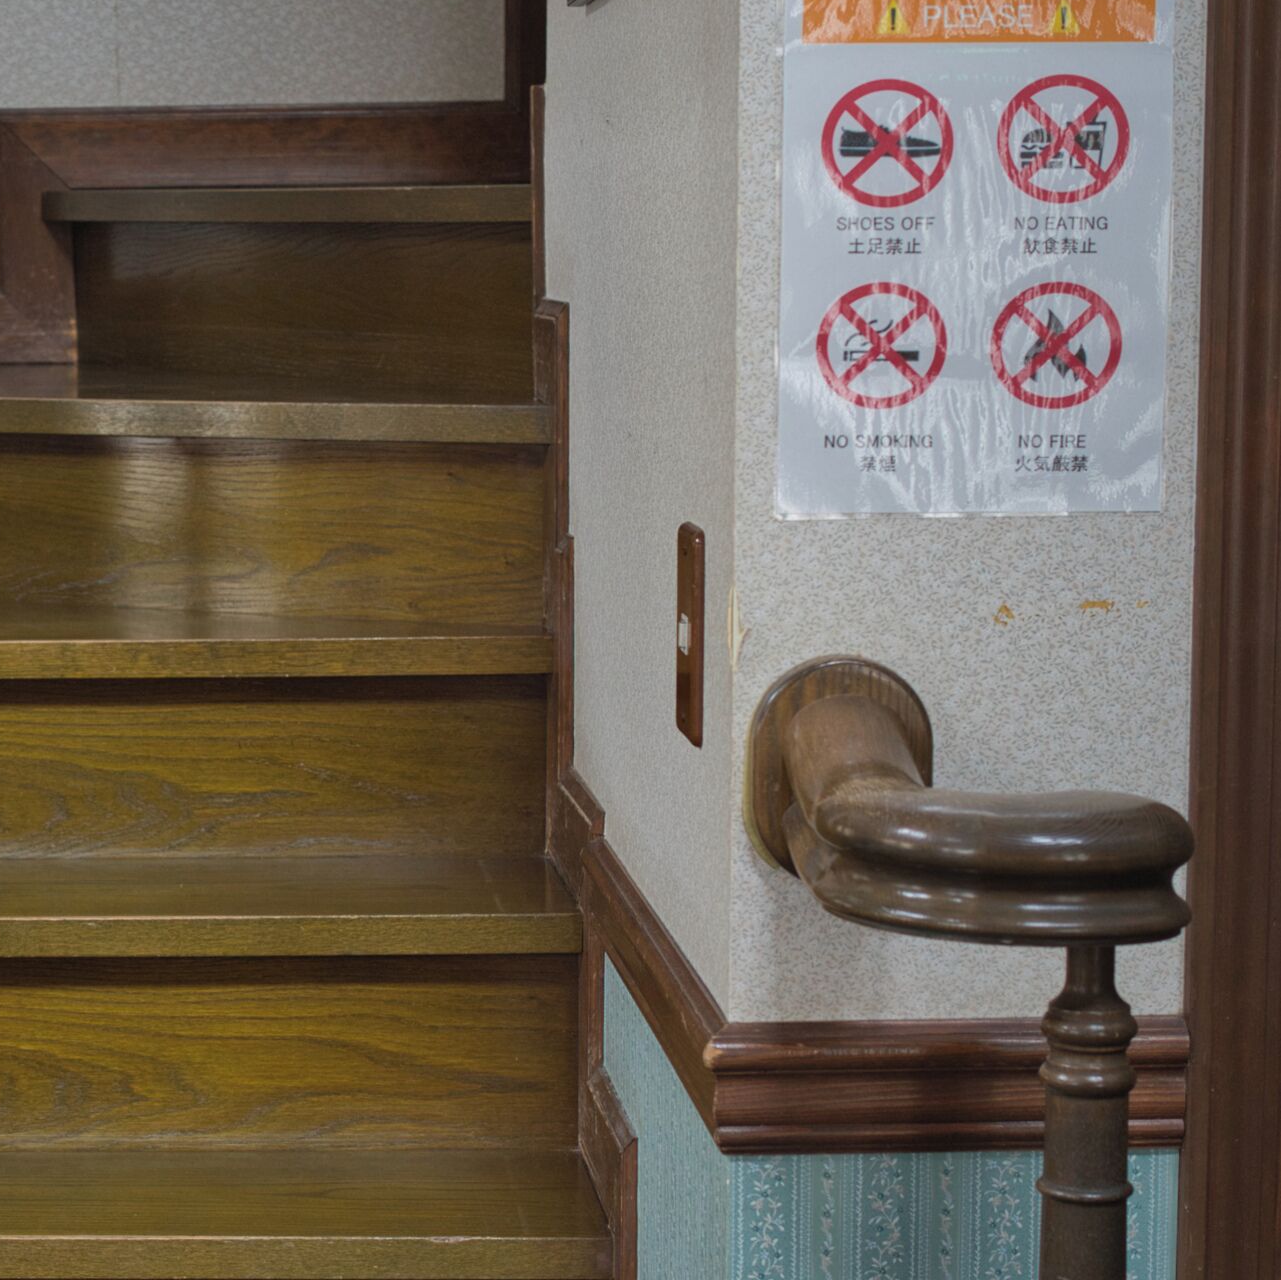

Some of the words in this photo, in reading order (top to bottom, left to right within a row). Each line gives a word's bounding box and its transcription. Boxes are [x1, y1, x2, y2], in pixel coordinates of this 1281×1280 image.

[923, 4, 1033, 29] PLEASE
[836, 216, 895, 231] SHOES
[901, 216, 936, 231] OFF
[1014, 216, 1039, 231] NO
[1045, 216, 1108, 231] EATING
[848, 237, 922, 255] 土足禁止
[1023, 237, 1097, 255] 飲食禁止
[824, 434, 848, 449] NO
[855, 434, 933, 449] SMOKING
[1018, 434, 1043, 449] NO
[1049, 434, 1087, 449] FIRE
[859, 455, 896, 472] 禁煙
[1014, 455, 1088, 473] 火気厳禁
